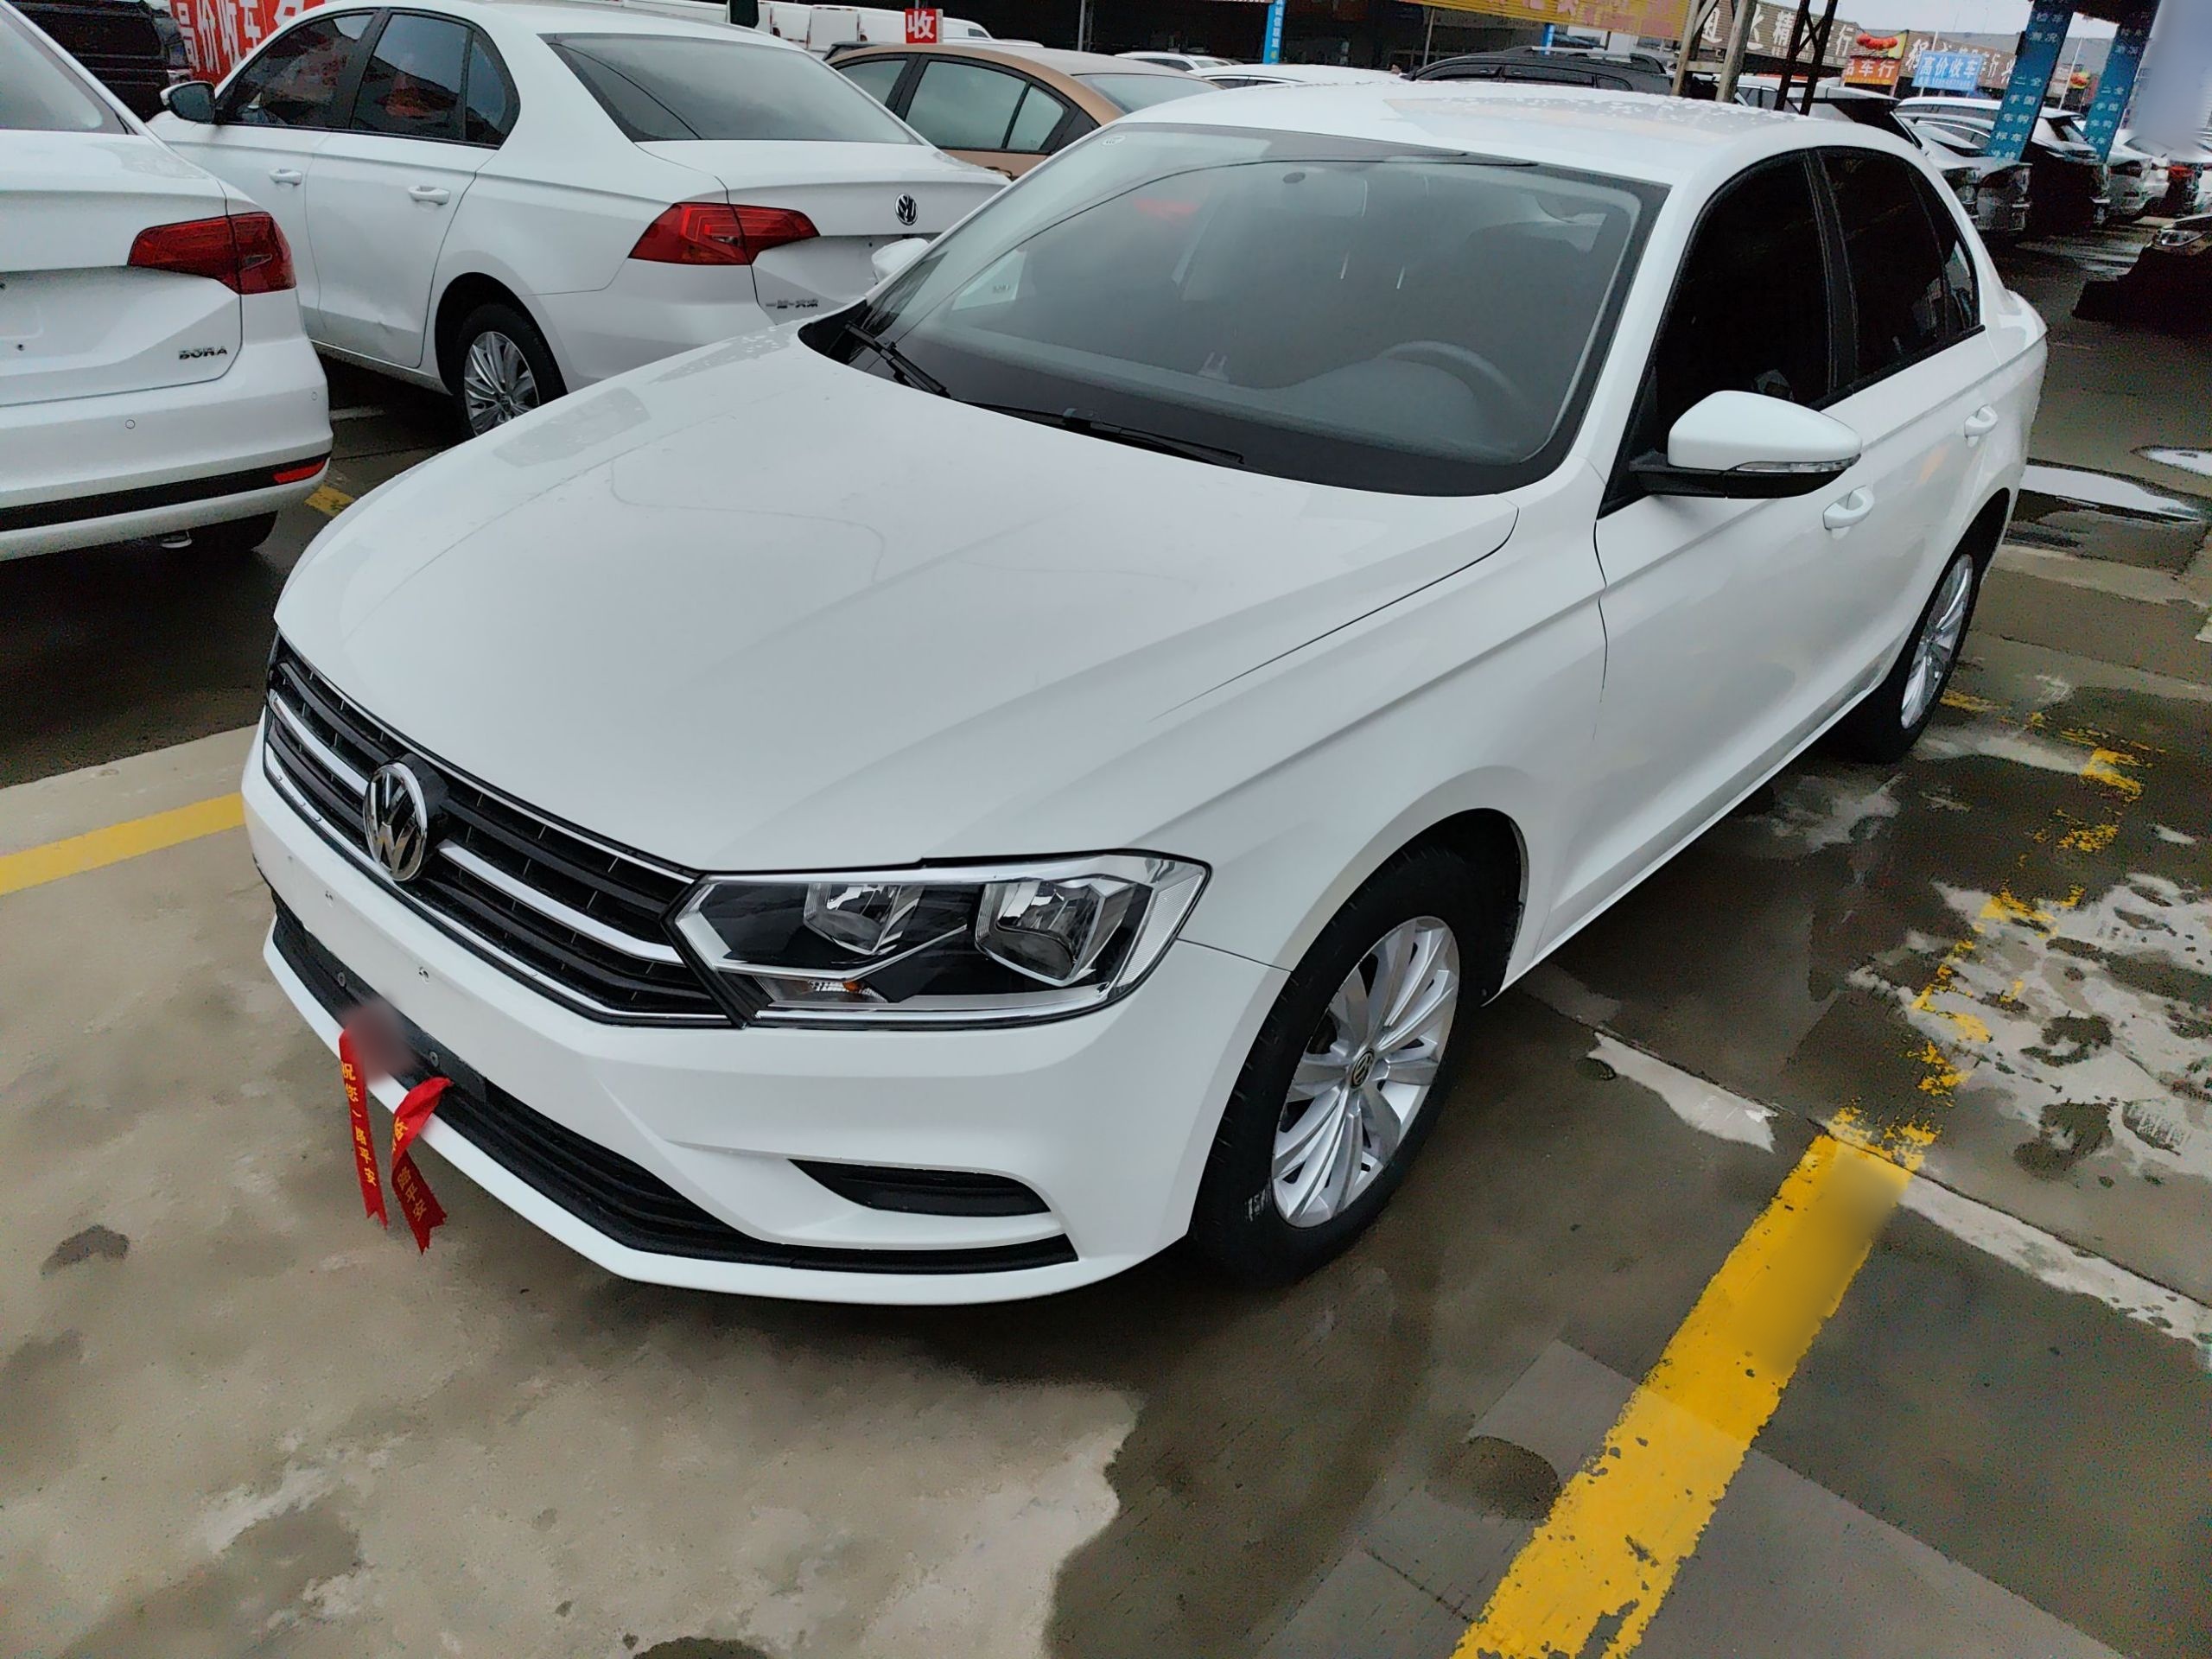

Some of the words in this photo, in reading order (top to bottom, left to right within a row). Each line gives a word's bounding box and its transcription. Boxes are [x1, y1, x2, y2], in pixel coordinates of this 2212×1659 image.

[907, 10, 935, 39] 收
[1918, 55, 1979, 80] 高价收车
[178, 346, 227, 360] BORA
